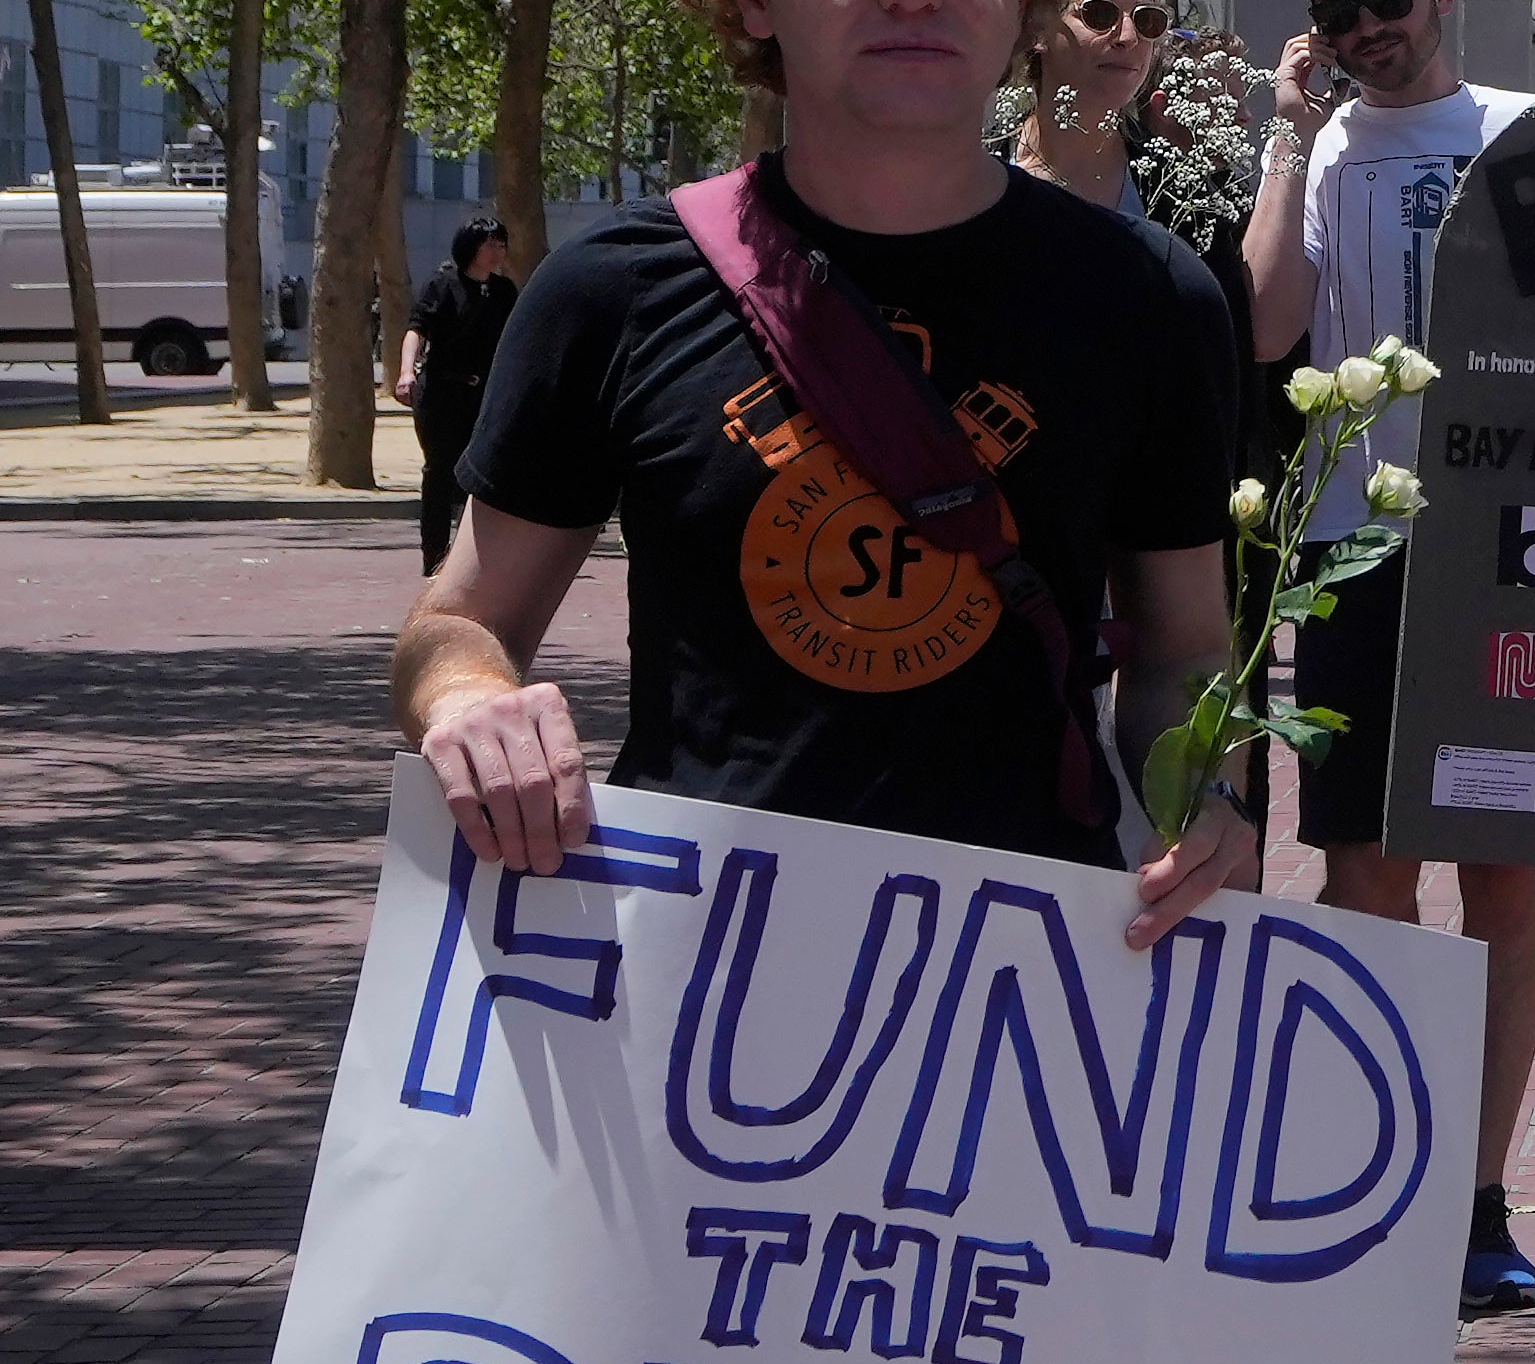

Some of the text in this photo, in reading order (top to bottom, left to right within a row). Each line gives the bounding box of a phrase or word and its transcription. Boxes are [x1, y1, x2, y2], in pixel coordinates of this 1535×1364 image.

[1401, 185, 1413, 229] BART
[1468, 351, 1485, 372] In
[1446, 424, 1525, 470] BAY
[773, 477, 829, 535] SAN
[840, 523, 922, 599] SF
[770, 590, 994, 676] TRANSIT RIDERS
[399, 824, 1433, 1282] FUND
